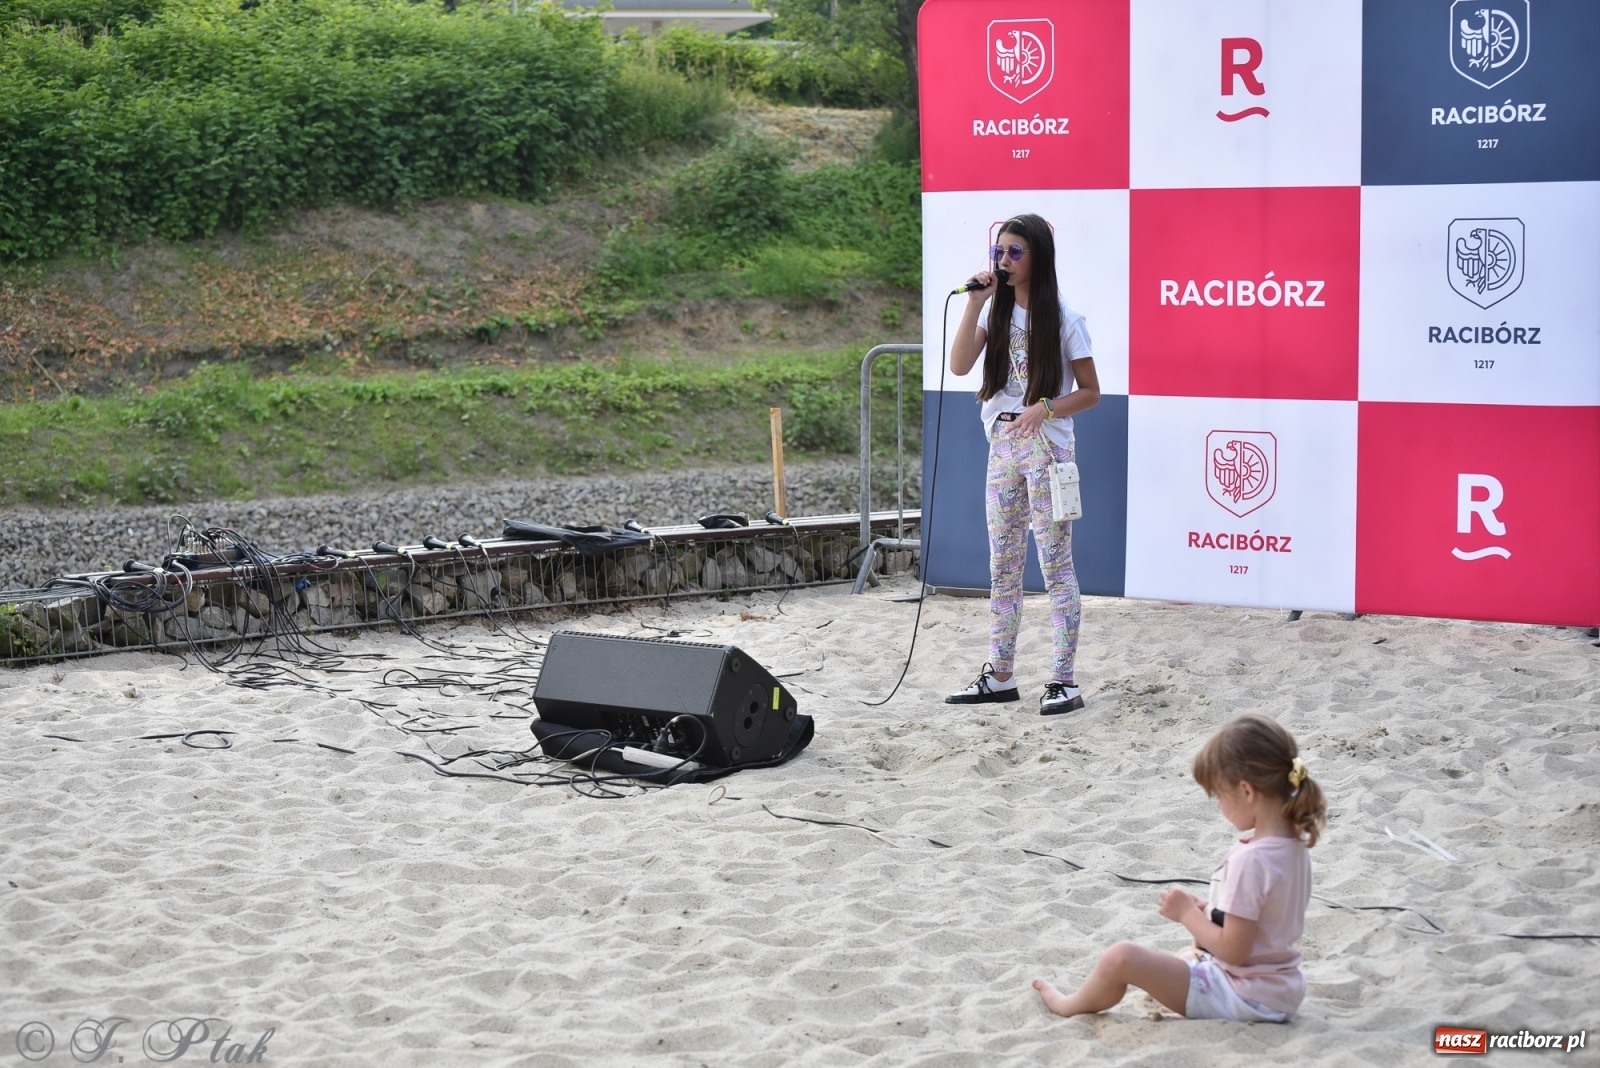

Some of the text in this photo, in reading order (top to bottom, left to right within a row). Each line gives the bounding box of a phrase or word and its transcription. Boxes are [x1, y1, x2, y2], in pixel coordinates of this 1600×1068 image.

[1220, 37, 1266, 96] R
[973, 112, 1070, 136] RACIBÓRZ
[1431, 98, 1547, 126] RACIBÓRZ
[1011, 149, 1030, 159] 1217
[1477, 138, 1499, 149] 1217
[1160, 270, 1326, 307] RACIBÓRZ
[1428, 320, 1542, 345] RACIBÓRZ
[1473, 359, 1495, 369] 1217
[1456, 473, 1507, 537] R
[1188, 529, 1292, 553] RACIBÓRZ
[1229, 565, 1249, 575] 1217
